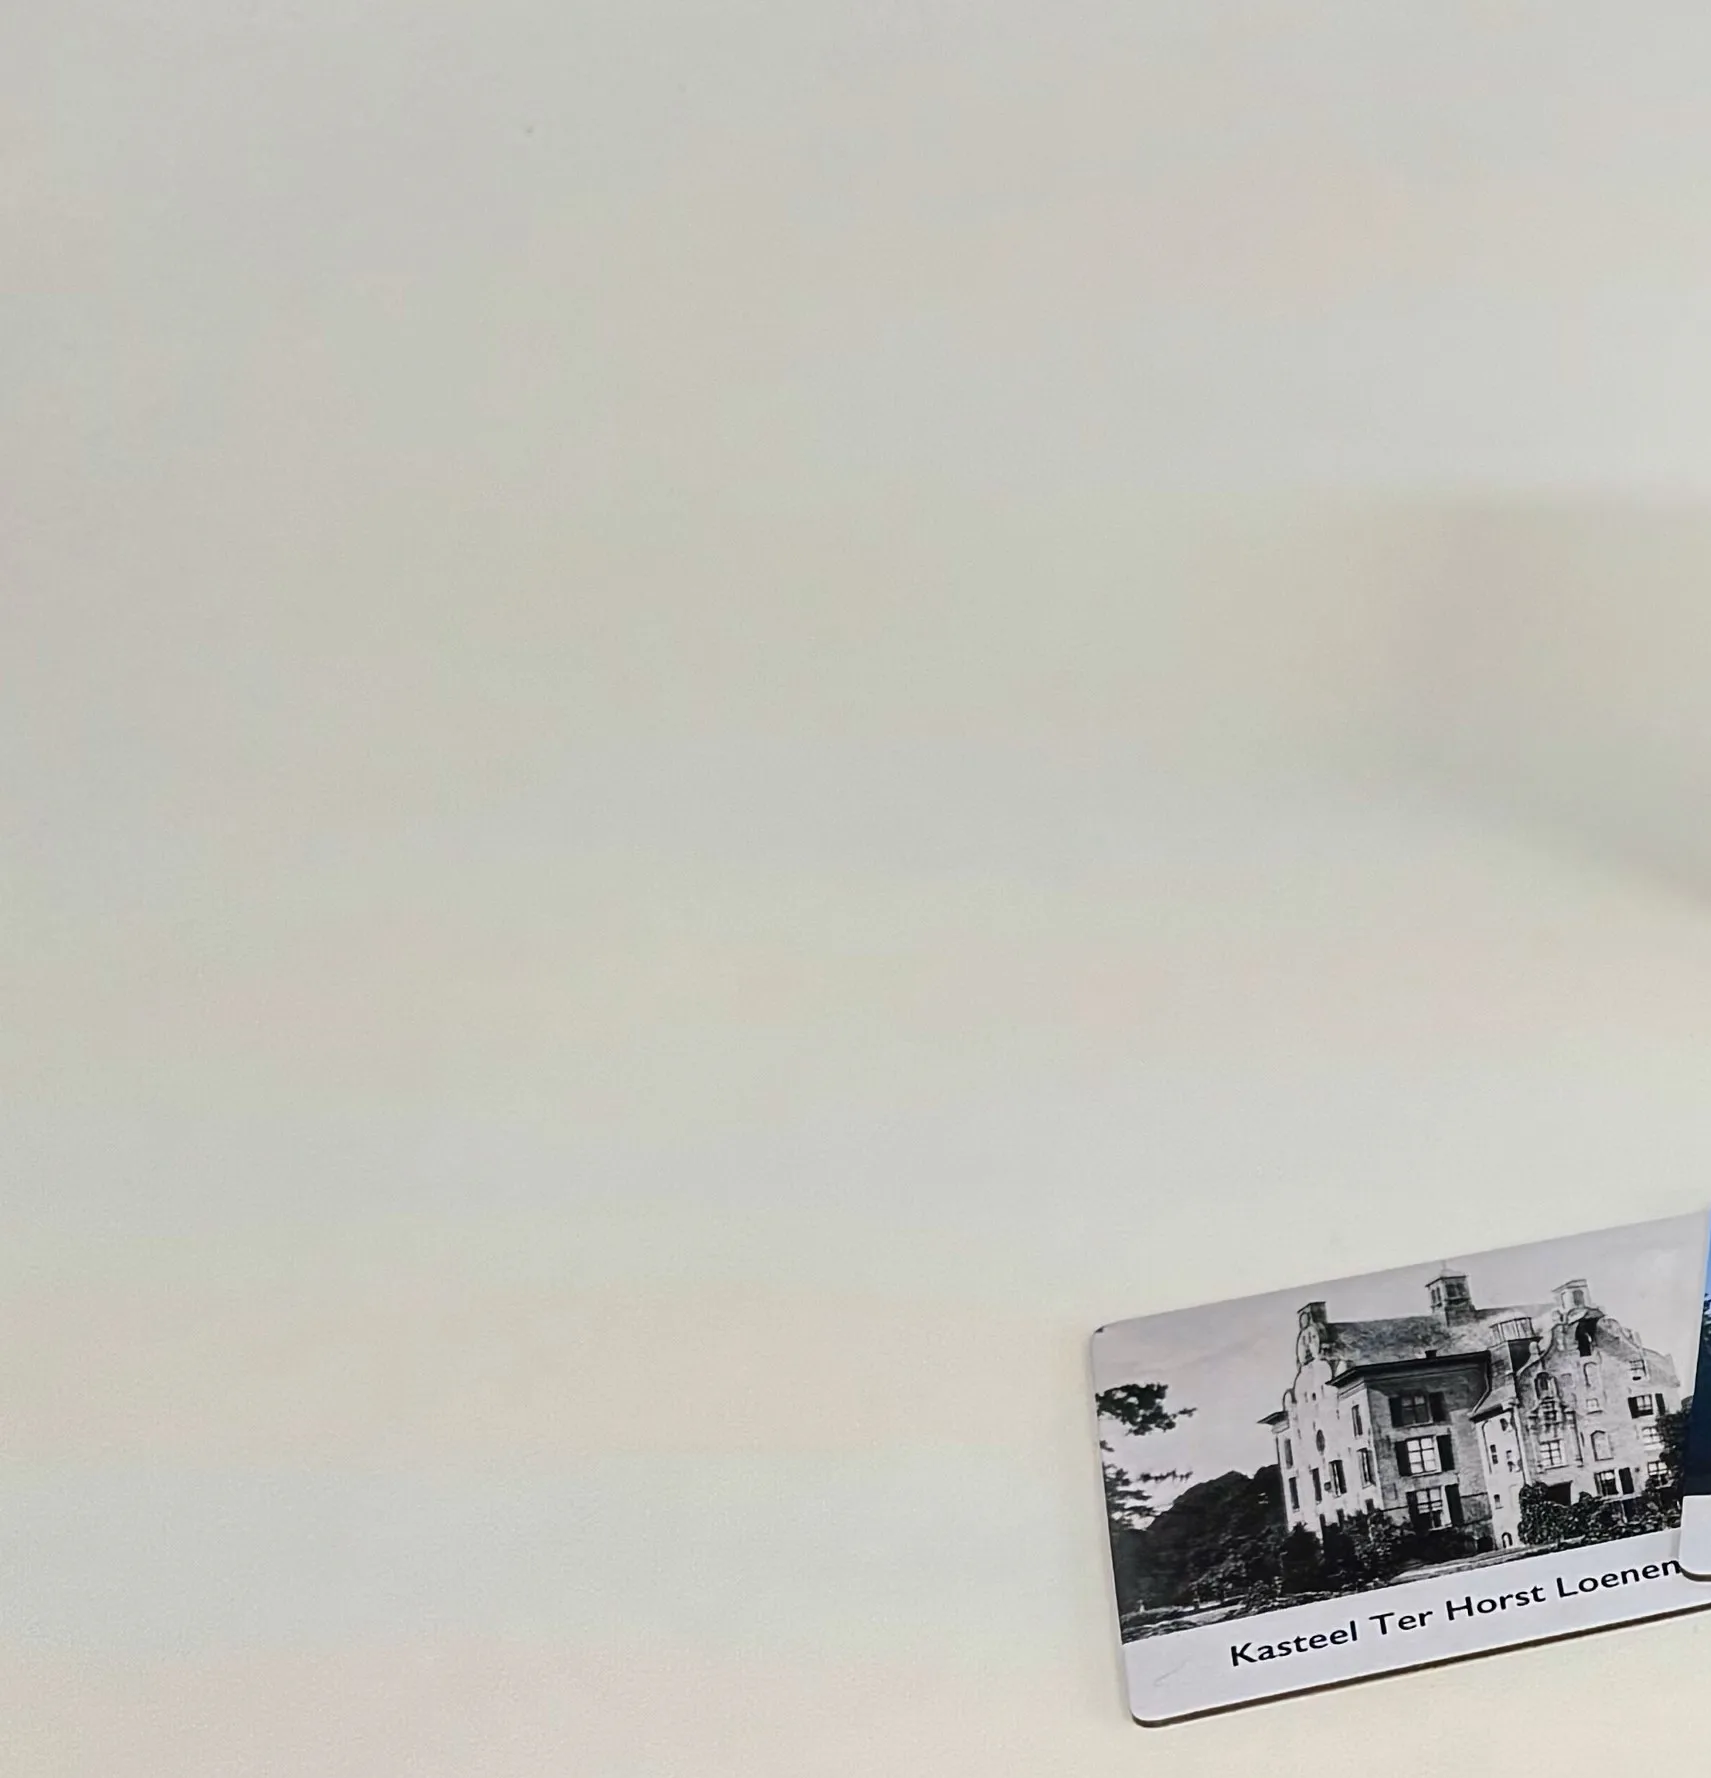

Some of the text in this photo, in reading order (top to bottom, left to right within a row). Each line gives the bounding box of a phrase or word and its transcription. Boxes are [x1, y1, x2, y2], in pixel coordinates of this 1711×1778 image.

[1231, 1561, 1681, 1666] Kasteel Ter Horst Loenen
